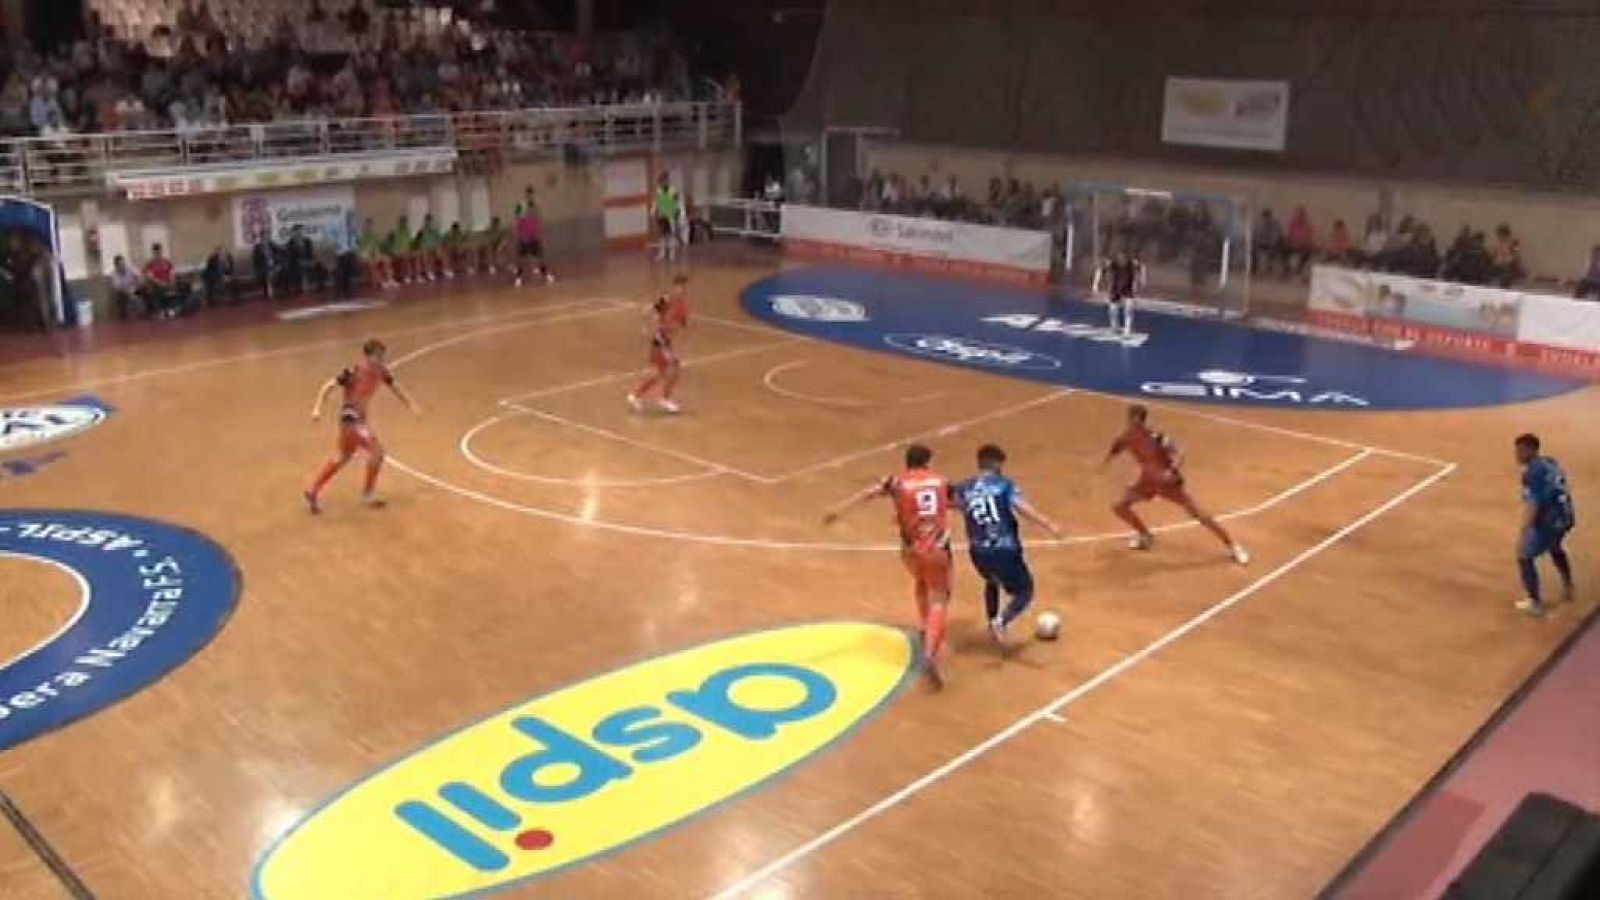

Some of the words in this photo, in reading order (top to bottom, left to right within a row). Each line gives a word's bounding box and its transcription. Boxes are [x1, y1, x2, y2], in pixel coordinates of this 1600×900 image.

[916, 488, 938, 516] 9
[968, 494, 1000, 525] 21
[394, 662, 837, 872] aspil
